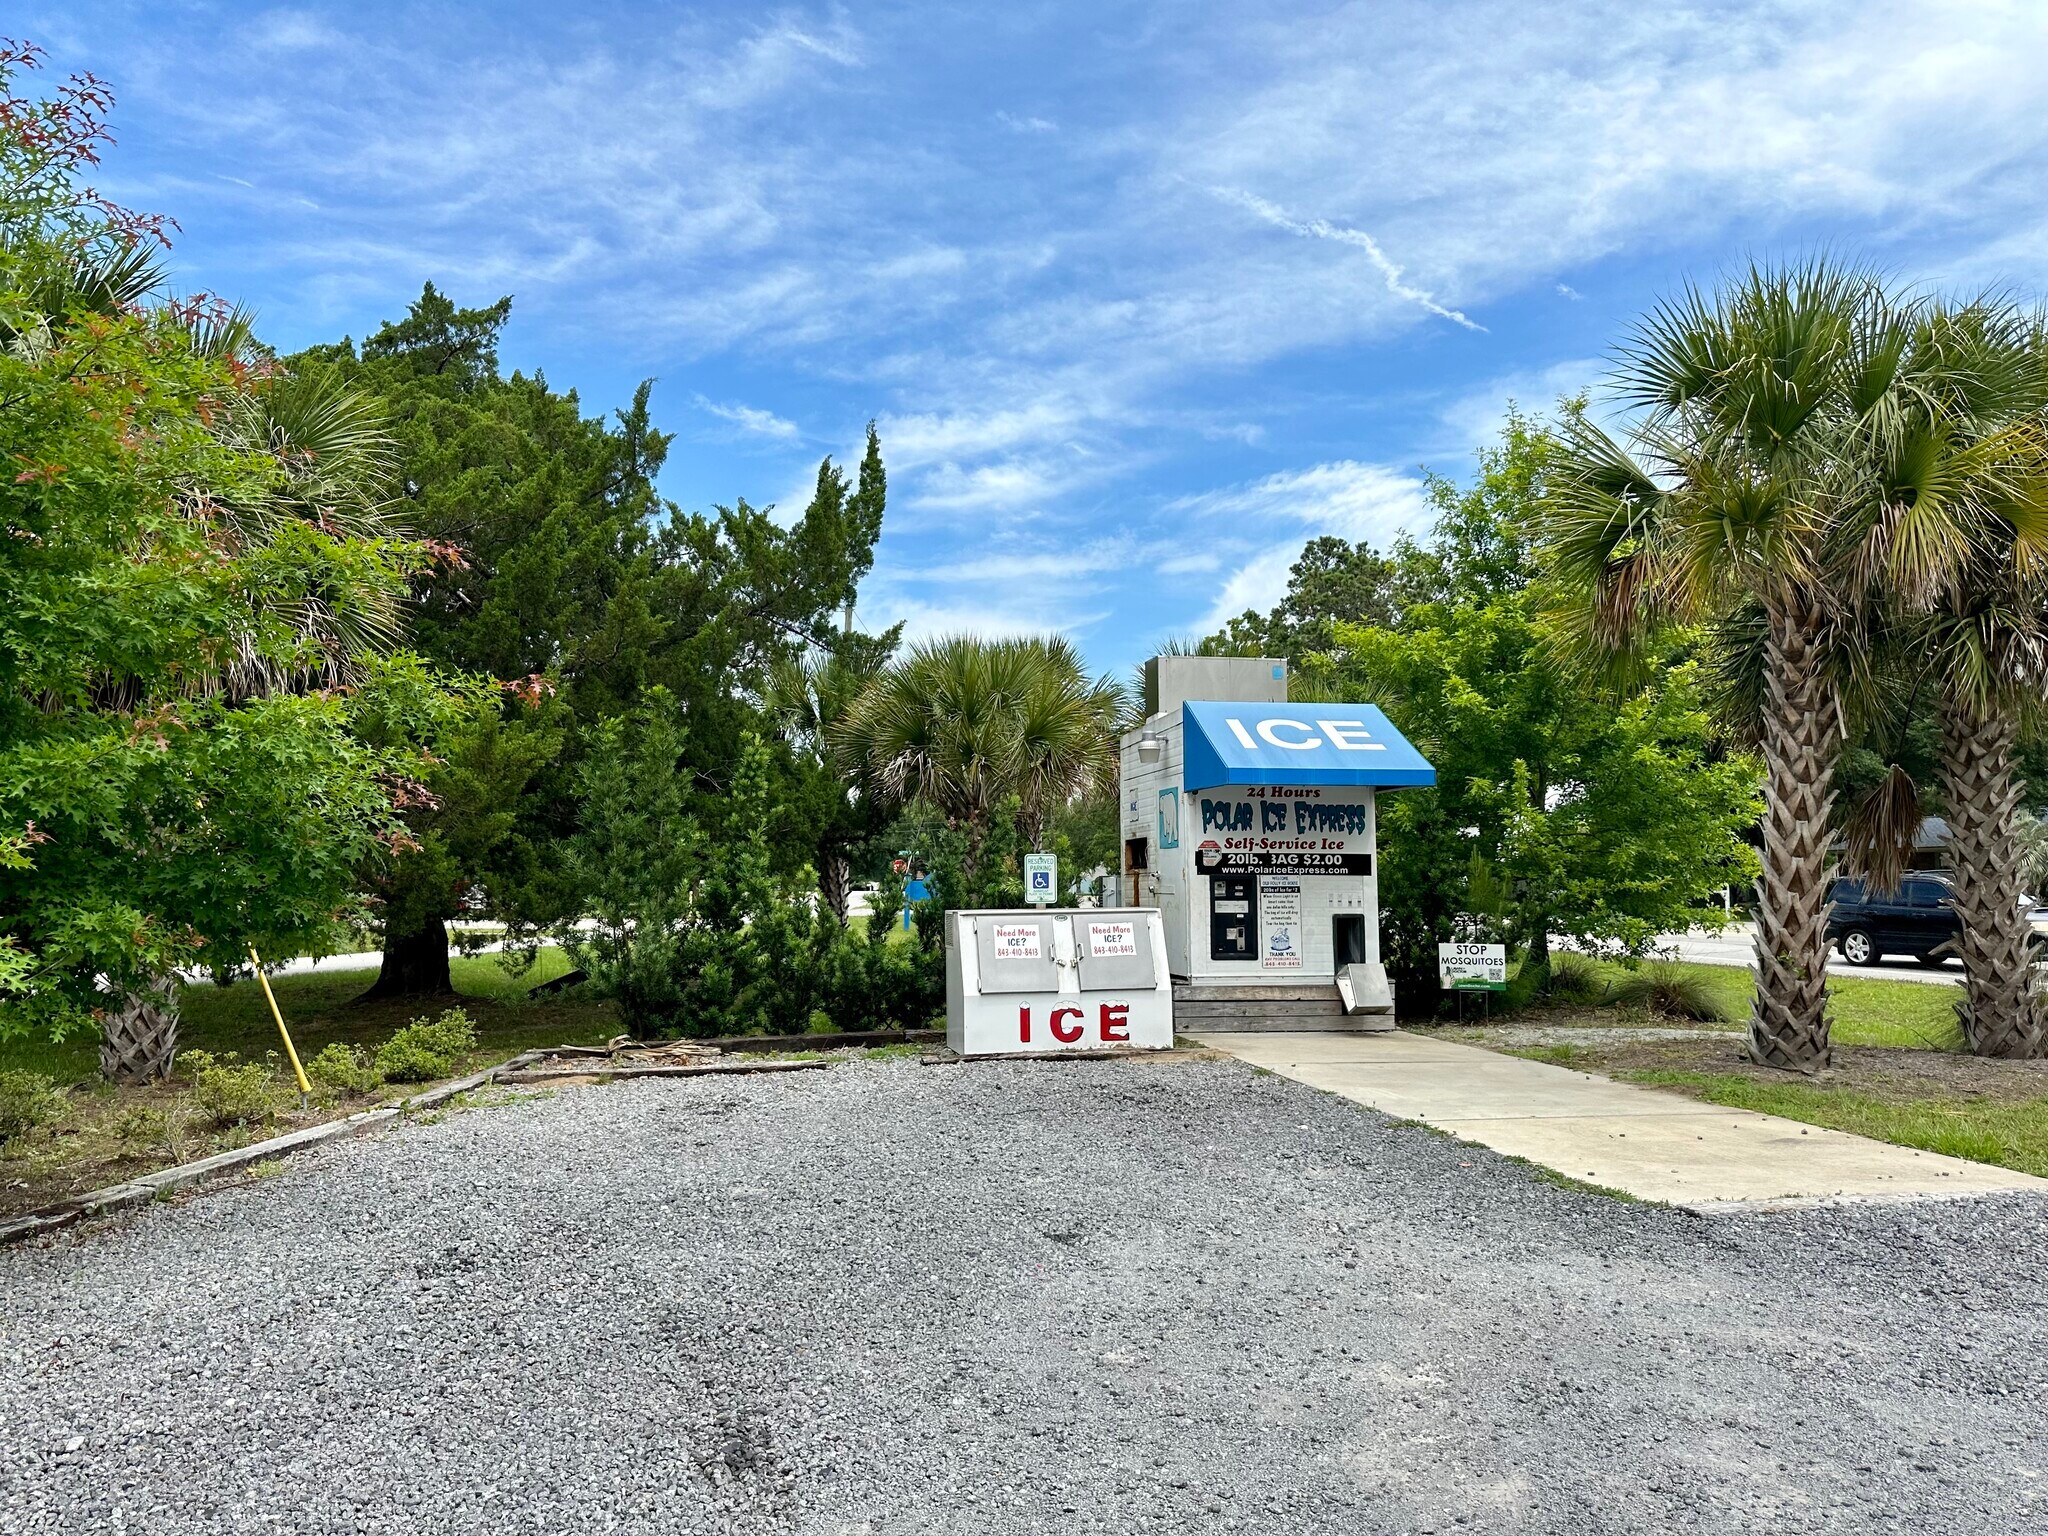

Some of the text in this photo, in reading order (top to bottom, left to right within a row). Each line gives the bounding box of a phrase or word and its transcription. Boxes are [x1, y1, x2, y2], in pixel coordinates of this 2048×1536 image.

[1224, 718, 1388, 751] ICE
[1247, 786, 1321, 798] 24 Hours
[1201, 798, 1366, 835] POLAR ICE EXPRESS
[1224, 837, 1317, 852] Self-Service
[1320, 838, 1345, 850] Ice
[1227, 853, 1263, 865] 20lb.
[1303, 853, 1342, 866] $2.00
[1222, 866, 1349, 875] www.PolarIceExpress.com
[996, 928, 1036, 937] Need More
[1092, 925, 1130, 934] Need More
[1007, 937, 1027, 947] ICE?
[1103, 934, 1123, 943] ICE?
[997, 948, 1039, 957] 843-410-8413
[1094, 945, 1134, 955] 843-410-8413
[1456, 945, 1487, 955] STOP
[1440, 956, 1504, 966] MOSQUITOES
[1019, 999, 1130, 1043] ICE
